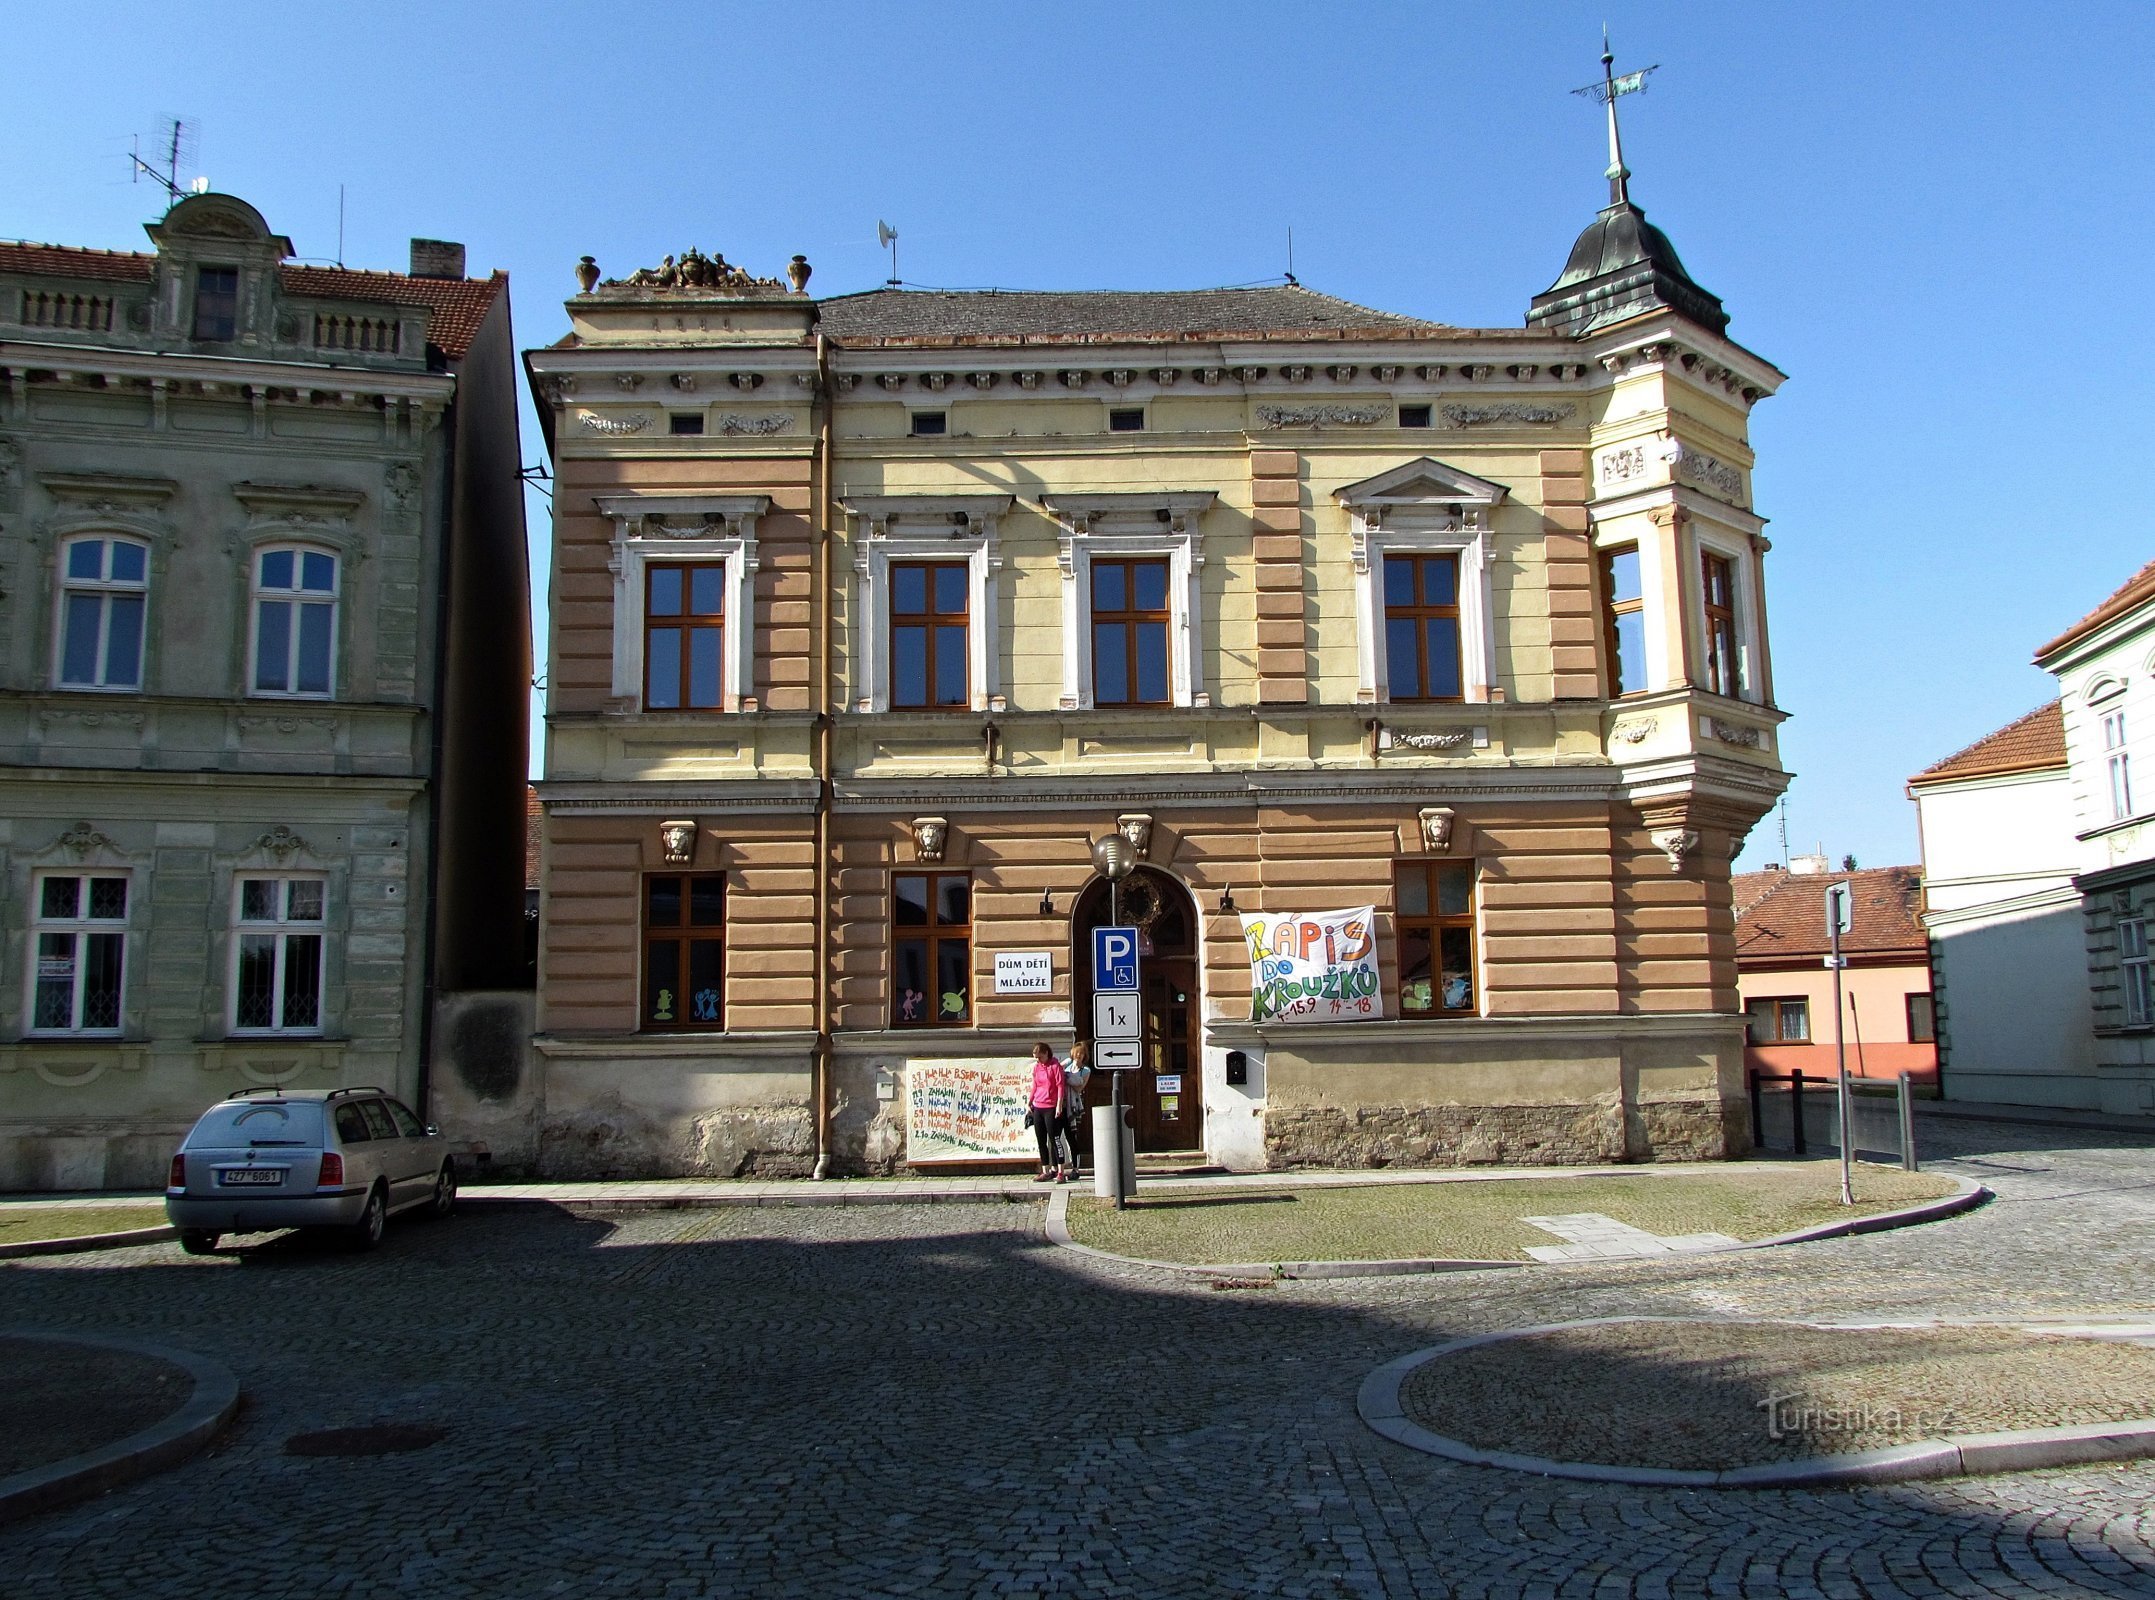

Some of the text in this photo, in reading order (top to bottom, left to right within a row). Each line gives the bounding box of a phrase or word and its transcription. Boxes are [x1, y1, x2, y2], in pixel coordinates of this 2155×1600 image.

[1105, 935, 1131, 971] P
[1026, 958, 1048, 968] DĚTÍ
[1261, 959, 1294, 981] DO
[1000, 976, 1047, 987] MLÁDEŽE
[1252, 963, 1378, 1021] KROUŽKŮ
[227, 1171, 277, 1182] 4Z7 6061
